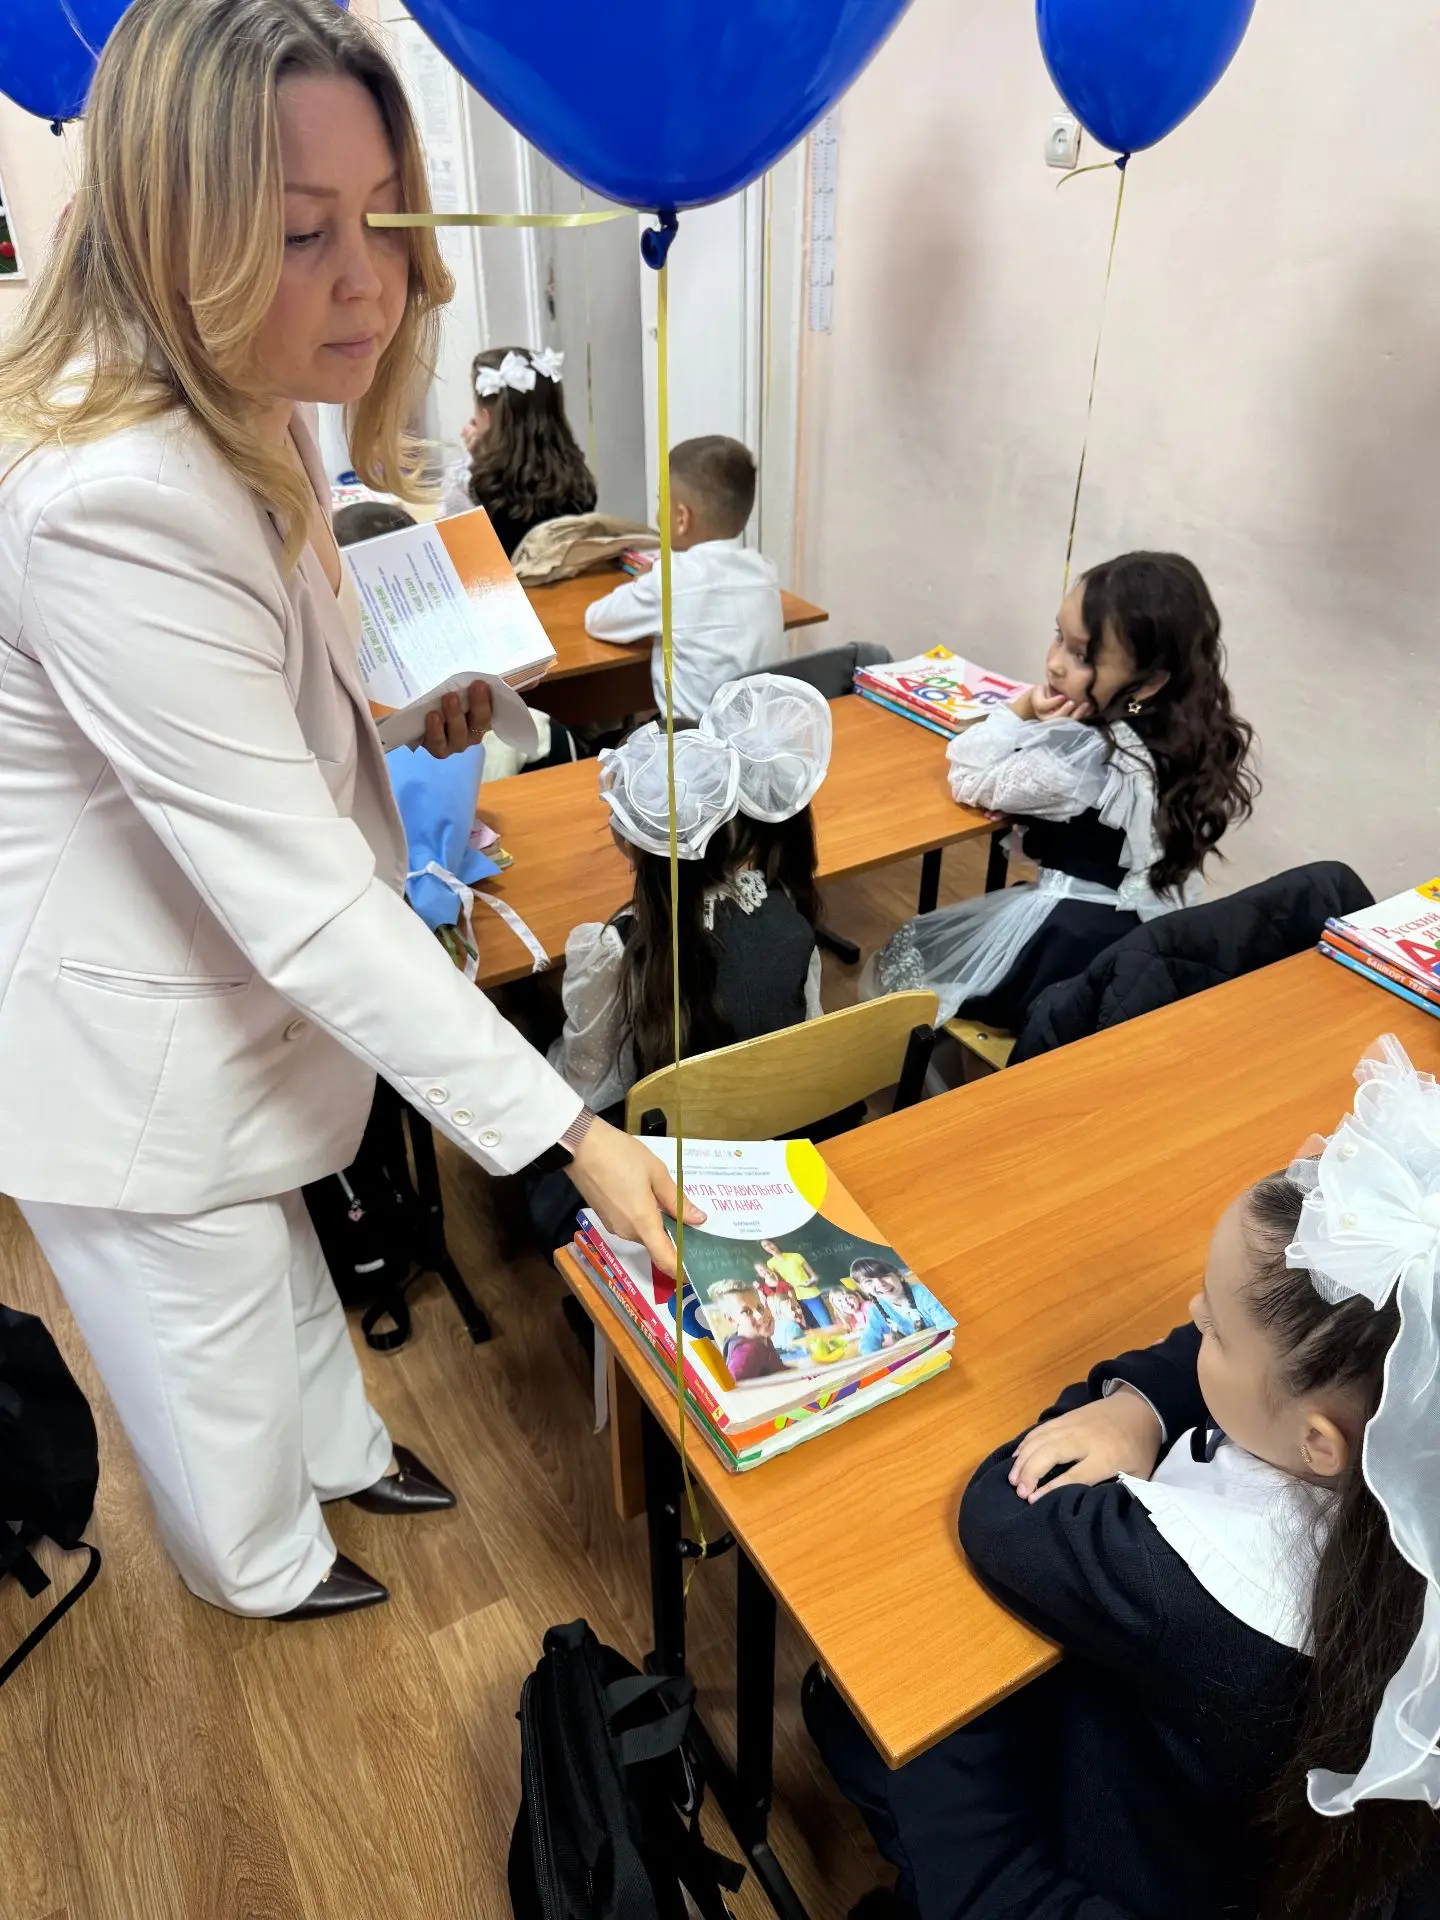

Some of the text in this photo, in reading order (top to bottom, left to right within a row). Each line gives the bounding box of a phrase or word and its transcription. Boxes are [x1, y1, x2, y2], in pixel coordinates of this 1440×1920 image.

[683, 1183, 794, 1198] МУЛА ПРАВИЛЬНОГО
[711, 1199, 764, 1213] ПИТАНИЯ
